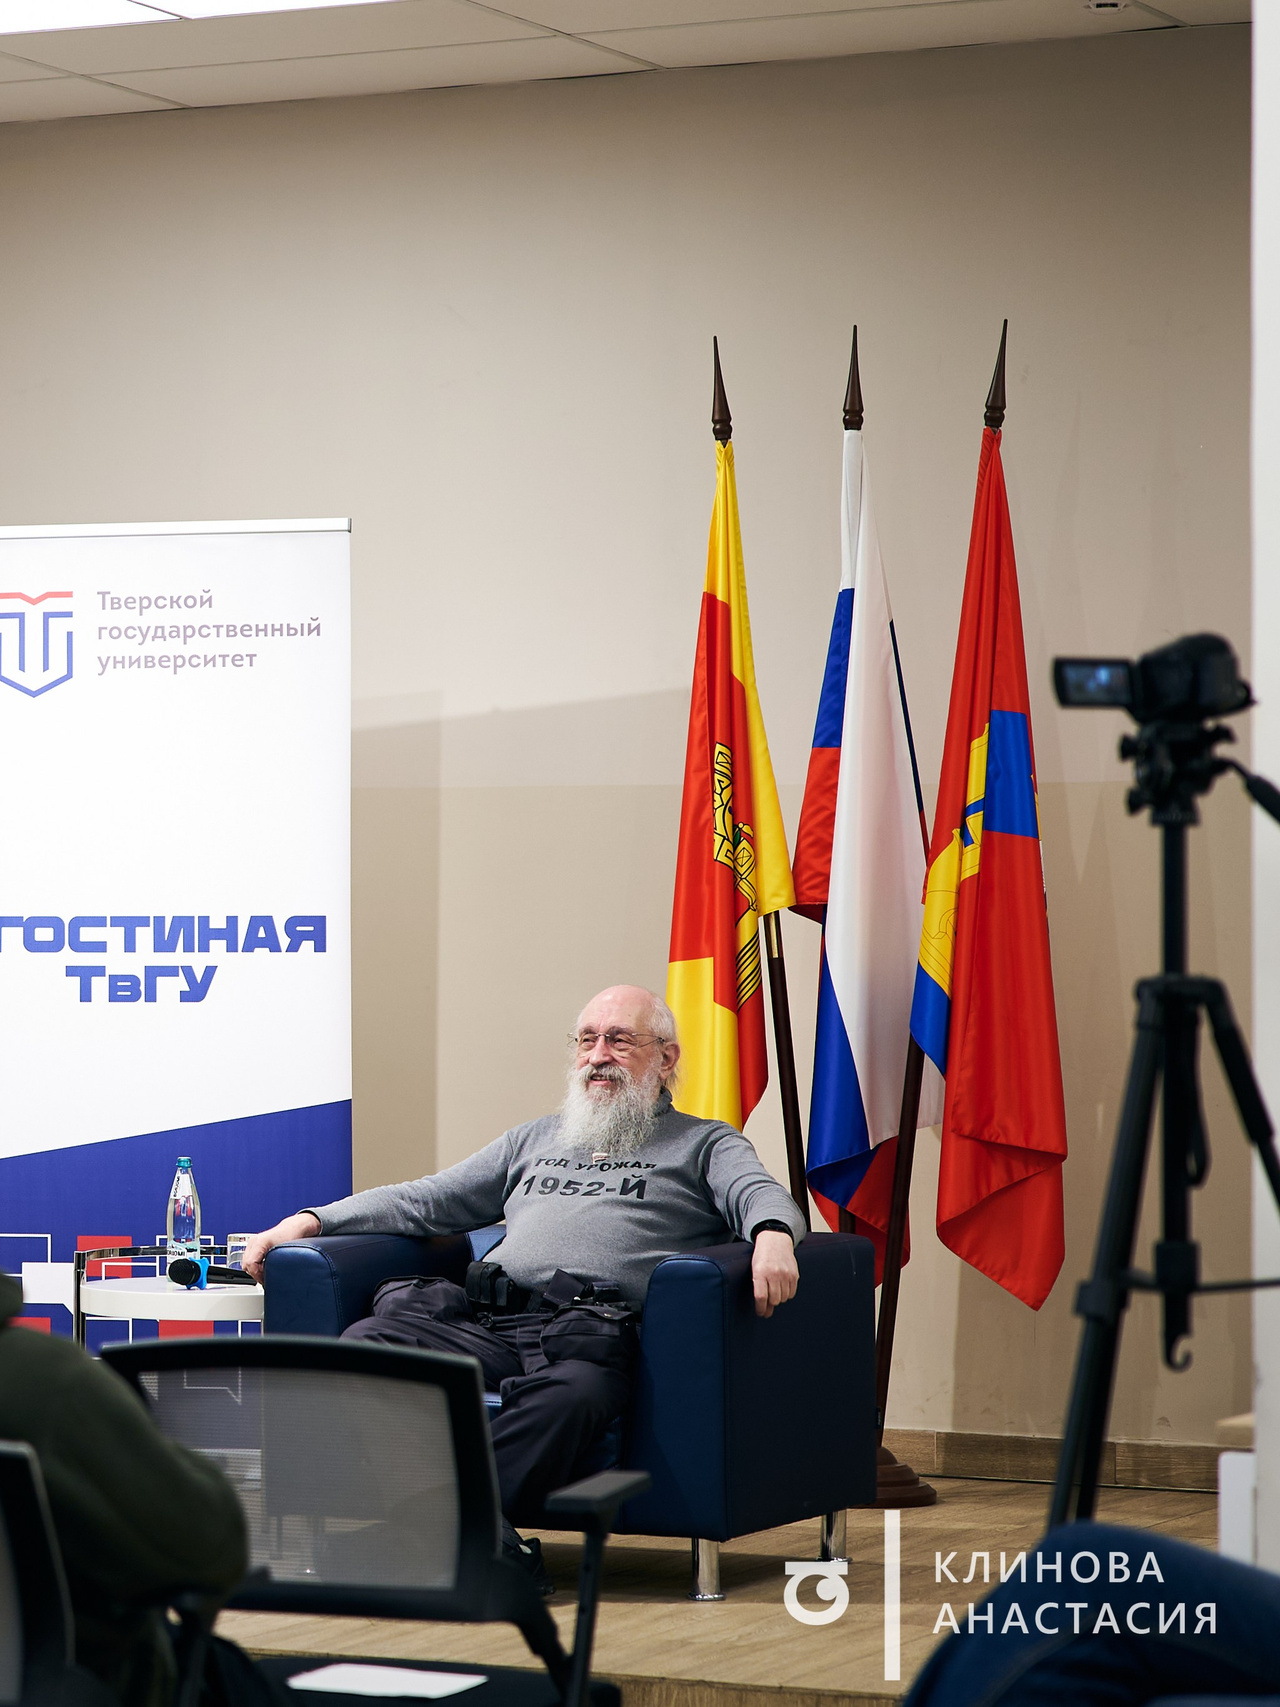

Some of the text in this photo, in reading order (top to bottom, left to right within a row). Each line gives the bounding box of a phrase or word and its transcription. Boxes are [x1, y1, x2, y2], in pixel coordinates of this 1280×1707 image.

[96, 589, 213, 616] Тверской
[97, 617, 322, 645] государственный
[97, 652, 258, 676] университет
[65, 965, 219, 1003] ТвГУ
[522, 1174, 648, 1200] 1952-Й
